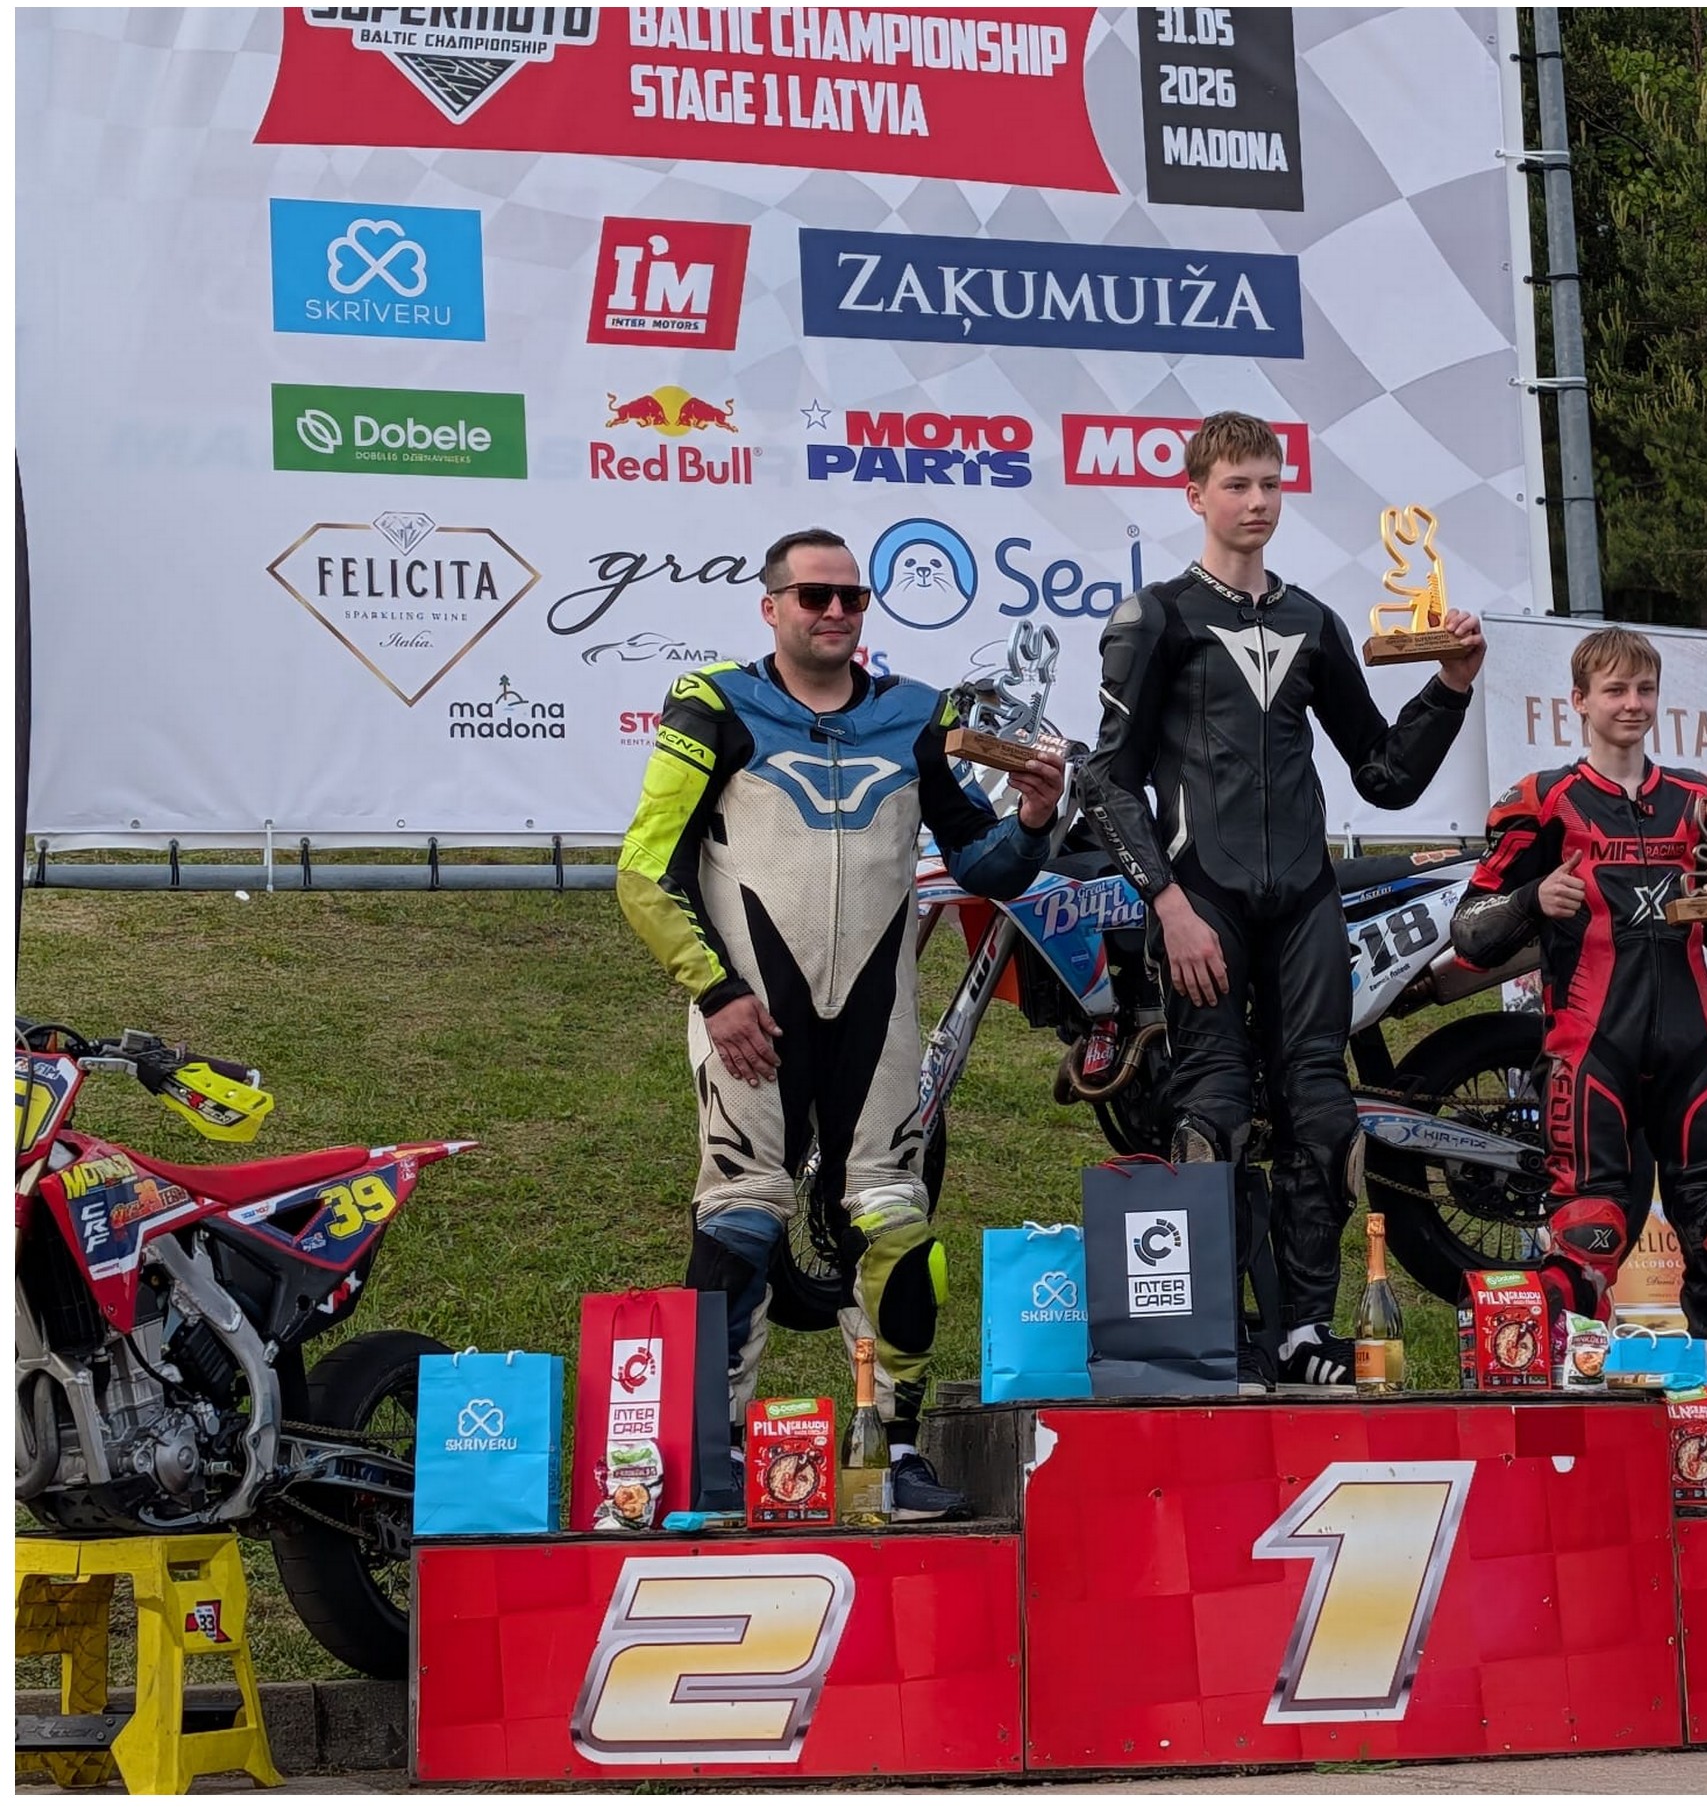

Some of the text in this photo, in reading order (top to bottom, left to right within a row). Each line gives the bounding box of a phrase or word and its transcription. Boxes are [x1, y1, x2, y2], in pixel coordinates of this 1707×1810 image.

[360, 28, 548, 56] BALTIC CHAMPIONSHIP
[630, 7, 1068, 78] BALTIC CHAMPIONSHIP
[1156, 7, 1236, 47] 31.05
[630, 64, 930, 138] STAGE 1 LATVIA
[1160, 64, 1237, 109] 2026
[1162, 125, 1290, 173] MADONA
[304, 297, 452, 327] SKRĪVERU
[836, 250, 1276, 337] ZAĶUMUIŽA
[611, 317, 700, 332] INTER MOTORS
[354, 414, 493, 453] Dobele
[845, 410, 1034, 451] MOTO
[590, 441, 753, 486] Red Bull
[807, 444, 1034, 489] PARTS
[316, 556, 500, 601] FELICITA
[994, 536, 1142, 620] Seal
[344, 609, 469, 622] SPARKLING WINE
[665, 649, 720, 663] AMR
[449, 718, 566, 740] madona
[1358, 902, 1440, 978] 18
[315, 1171, 398, 1241] 39
[80, 1201, 110, 1255] CRF
[1133, 1278, 1186, 1294] INTER
[1133, 1292, 1187, 1308] CARS
[612, 1407, 655, 1421] INTER
[612, 1420, 655, 1435] CARS
[1250, 1459, 1478, 1727] 1
[197, 1612, 217, 1635] 33
[568, 1553, 856, 1765] 2
